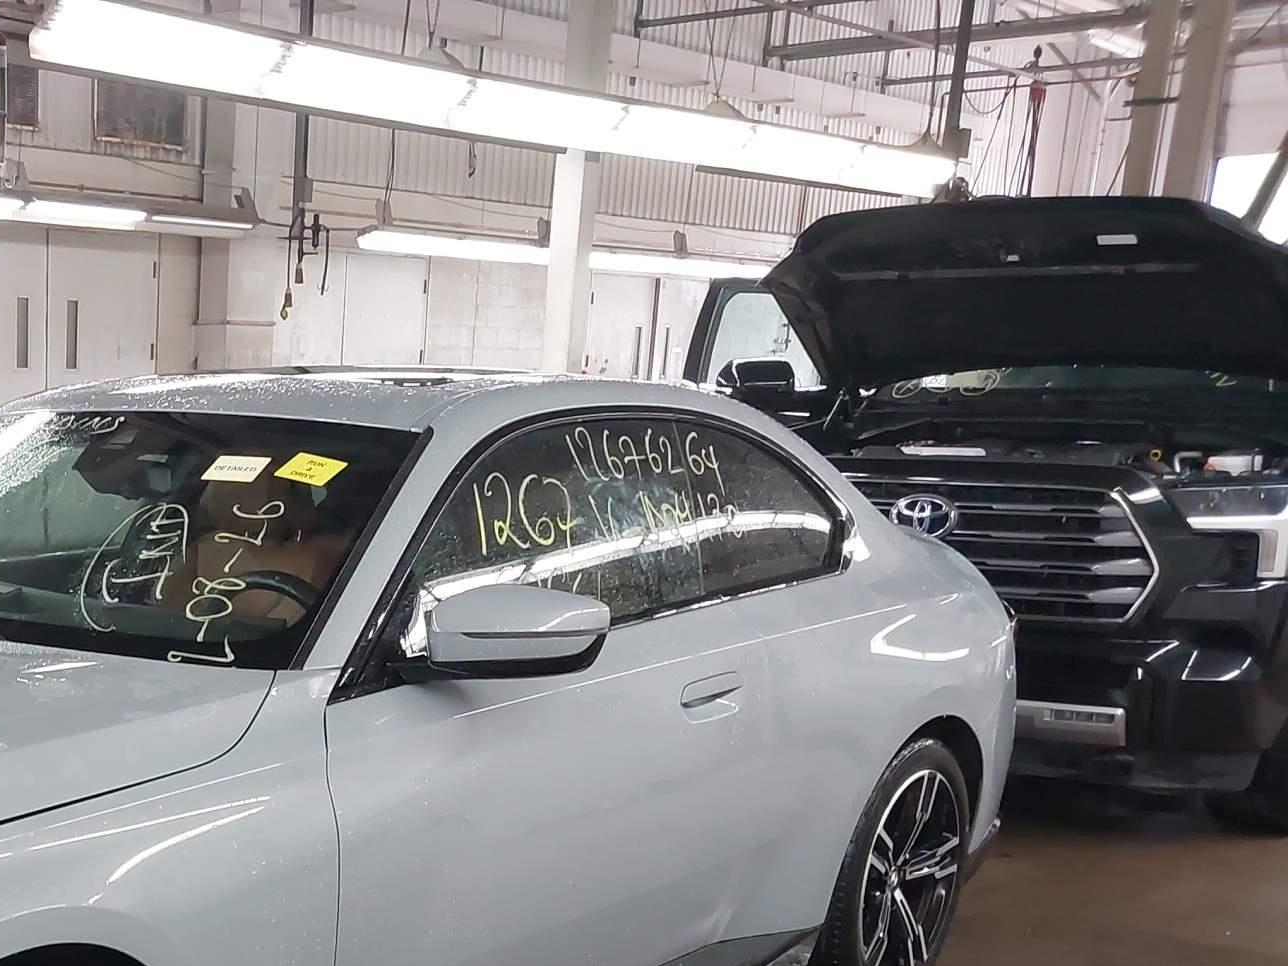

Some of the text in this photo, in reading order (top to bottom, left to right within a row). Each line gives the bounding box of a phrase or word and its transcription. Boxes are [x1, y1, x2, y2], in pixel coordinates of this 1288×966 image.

[306, 459, 328, 468] RUN
[565, 426, 726, 496] 12676264
[214, 464, 257, 473] DETAILED
[289, 470, 317, 481] DRIVE
